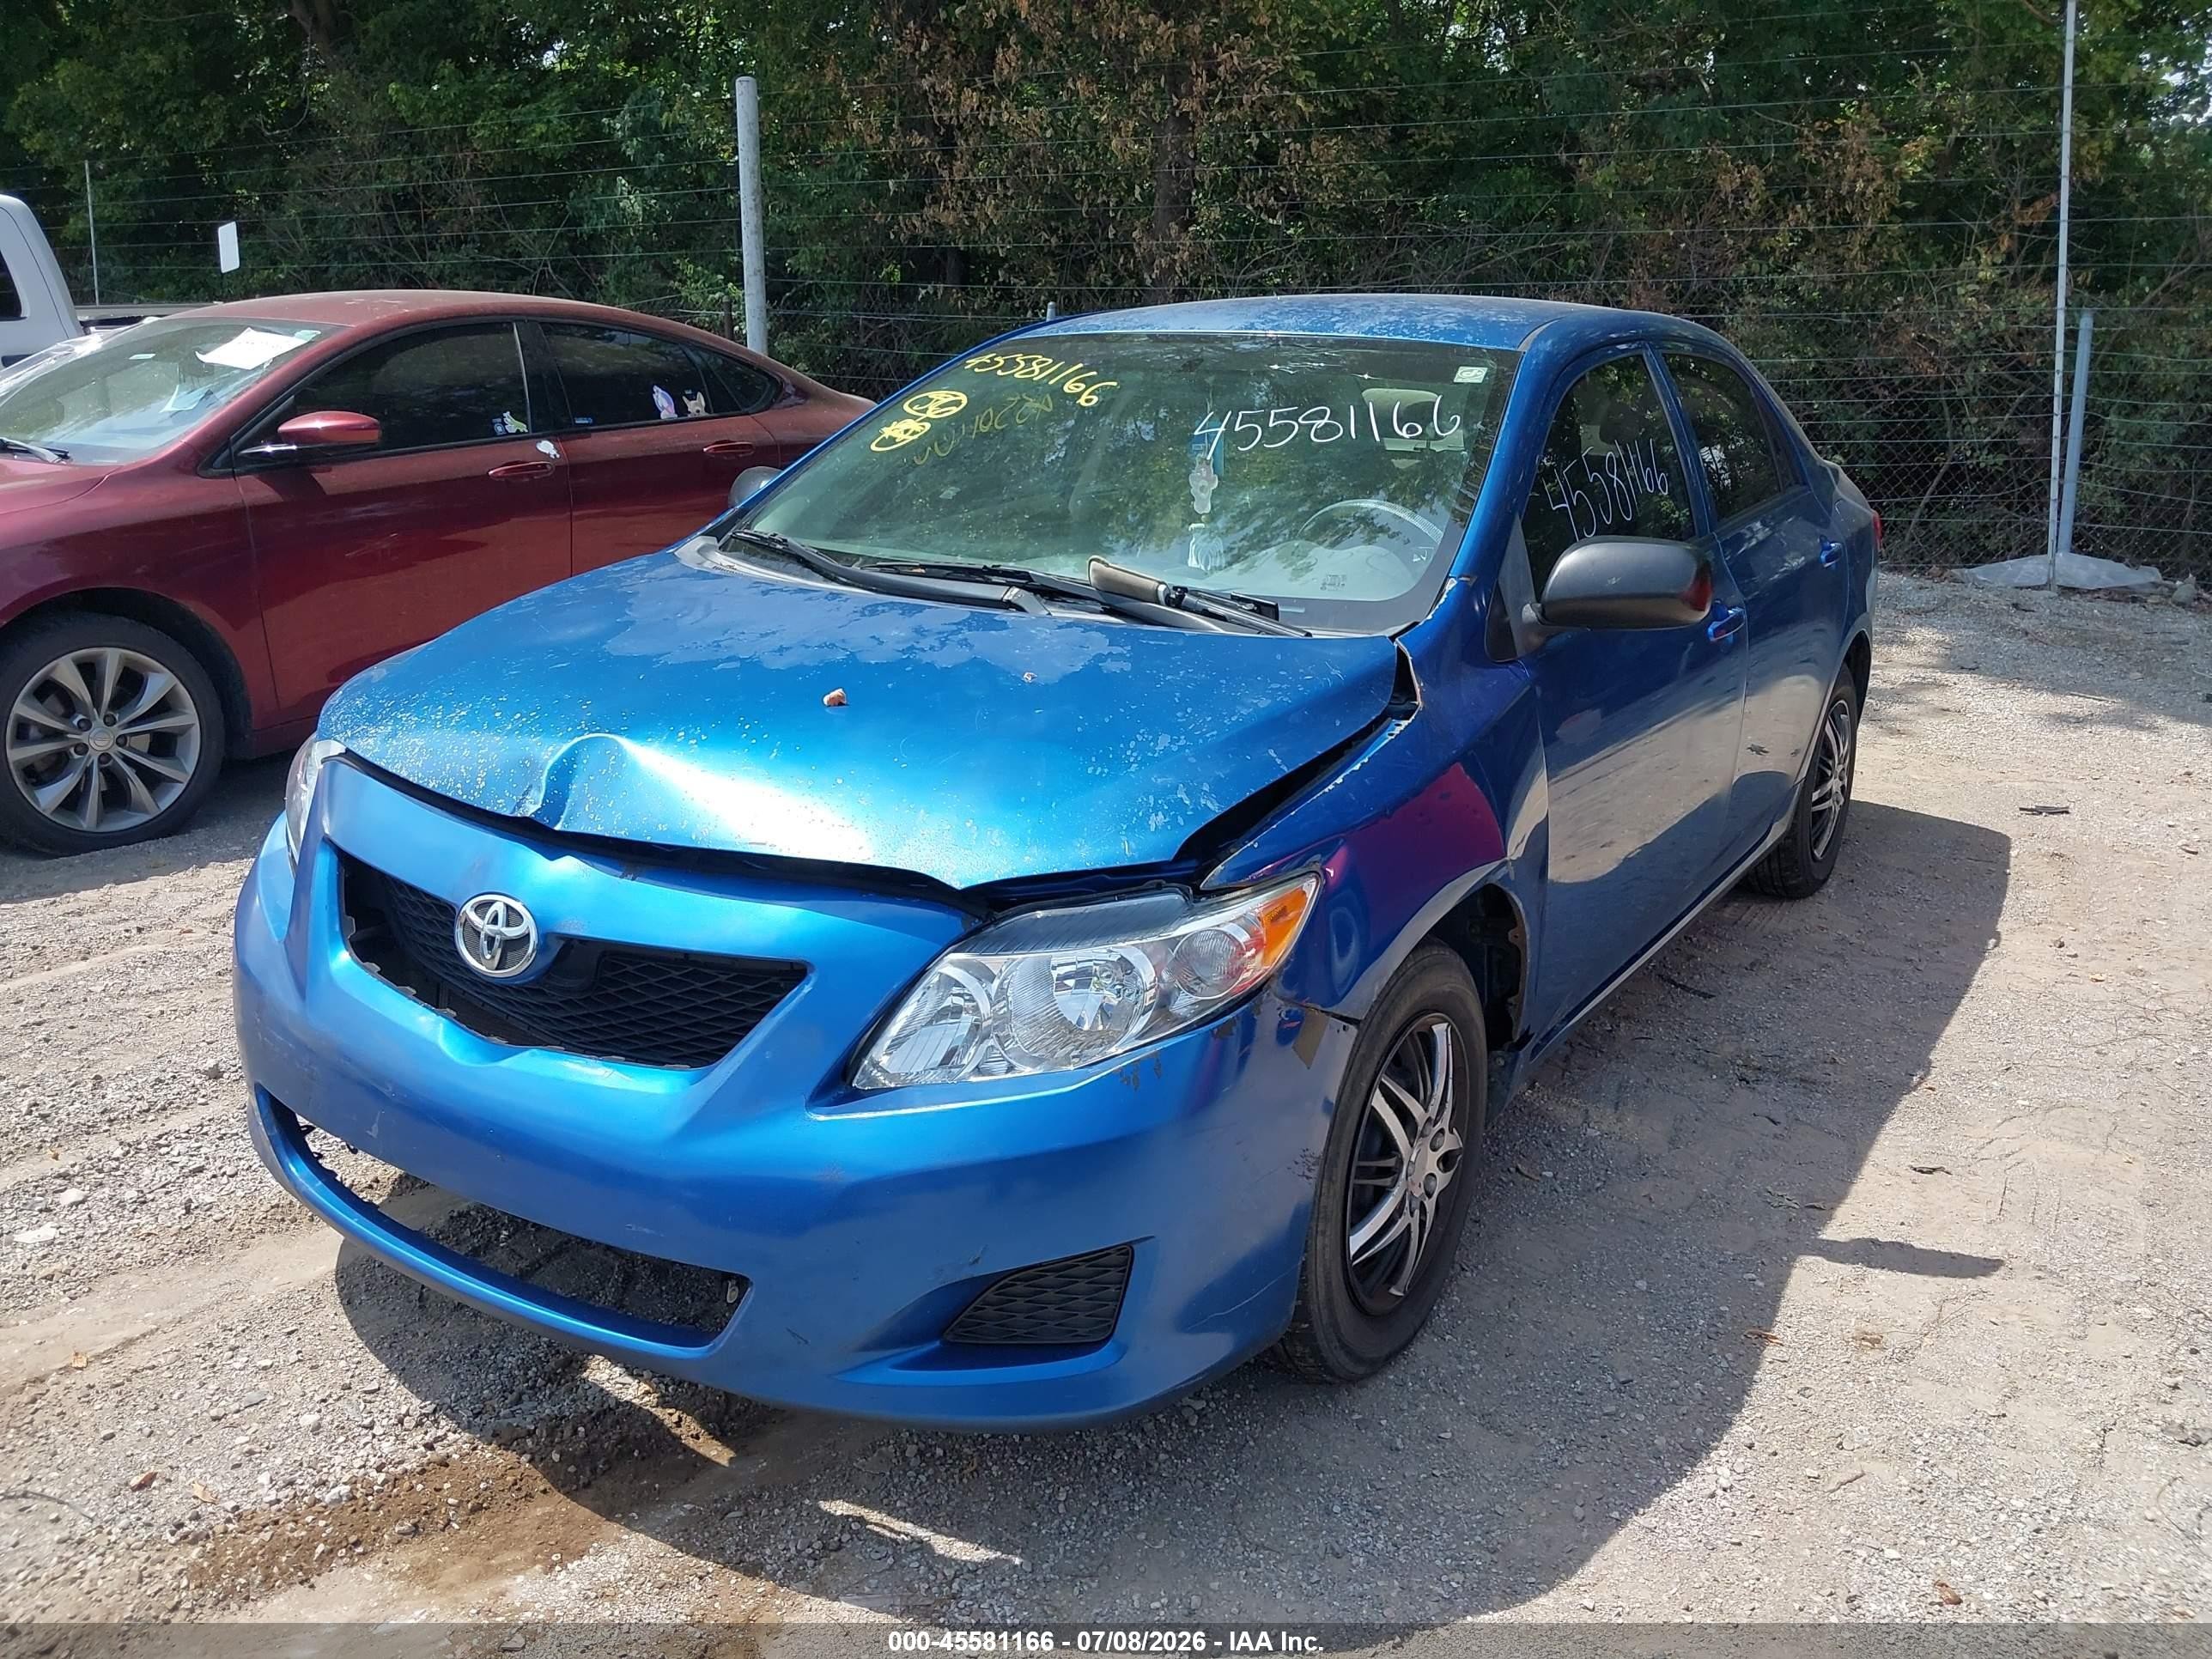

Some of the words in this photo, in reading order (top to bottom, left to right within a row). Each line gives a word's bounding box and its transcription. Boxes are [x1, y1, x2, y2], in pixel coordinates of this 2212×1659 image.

[964, 353, 1119, 407] 45581166
[1193, 394, 1461, 460] 45581166
[1541, 438, 1668, 542] 45581166
